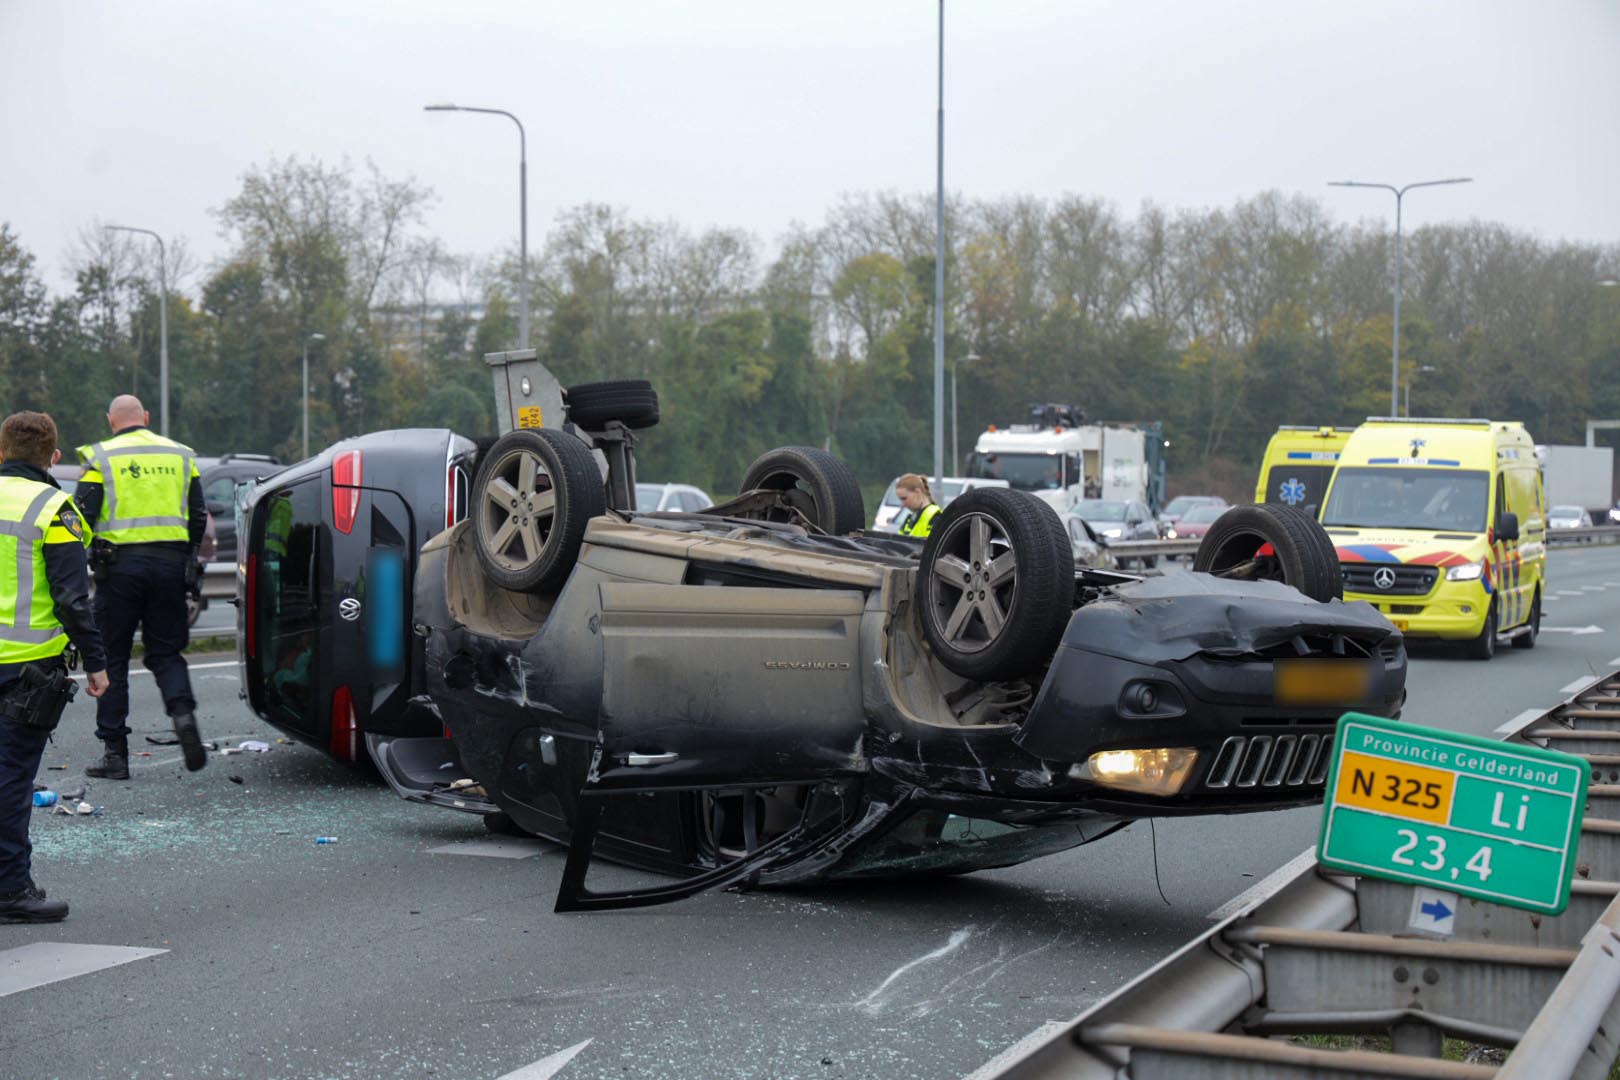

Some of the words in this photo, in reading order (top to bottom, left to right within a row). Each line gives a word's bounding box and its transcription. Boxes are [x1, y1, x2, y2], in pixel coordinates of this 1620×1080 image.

[765, 661, 851, 670] COMPASS
[1363, 734, 1449, 763] Provincie
[1455, 752, 1559, 786] Gelderland
[1351, 768, 1375, 797] N
[1381, 775, 1442, 810] 325
[1491, 791, 1530, 831] Li
[1391, 829, 1493, 881] 23,4
